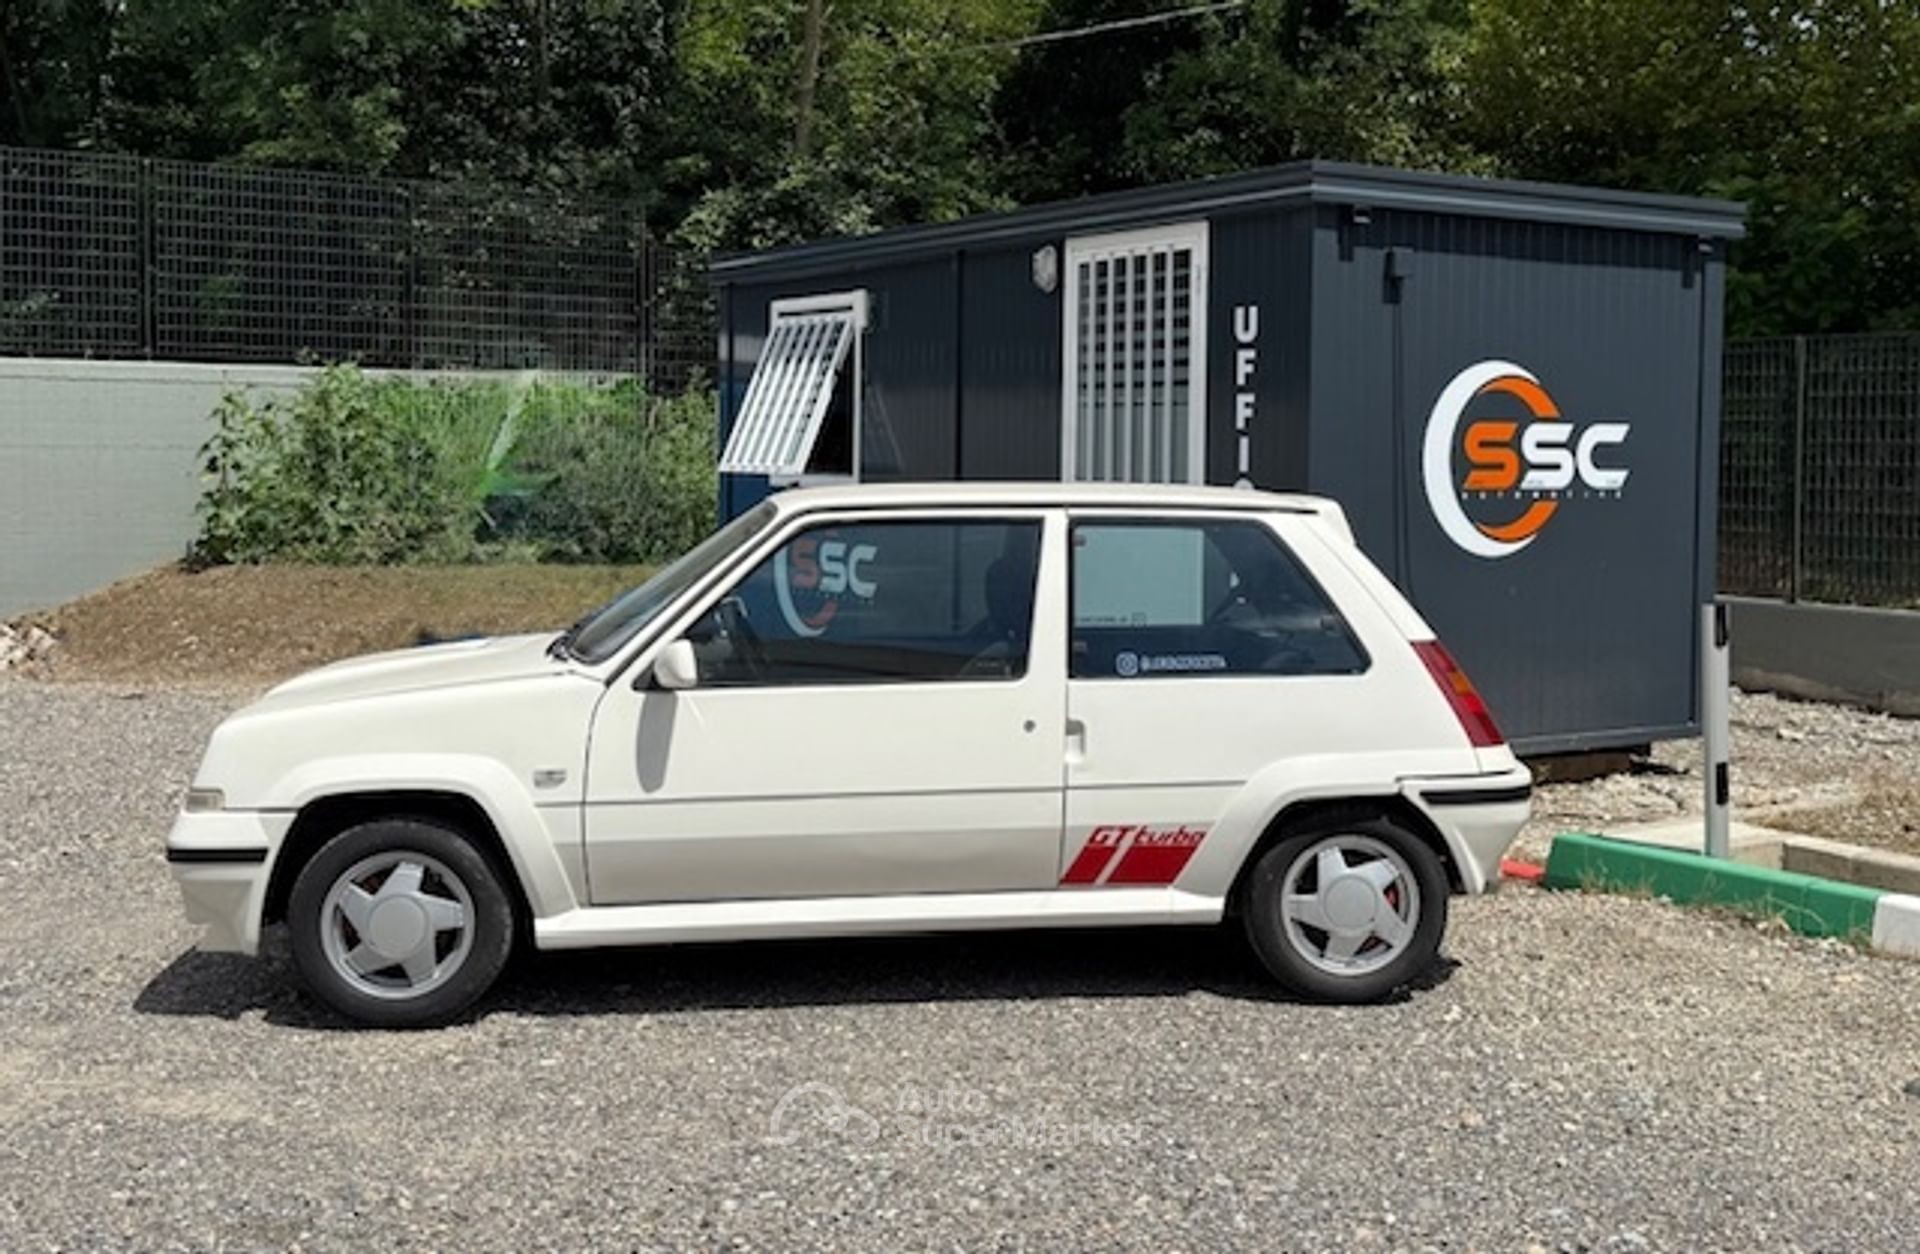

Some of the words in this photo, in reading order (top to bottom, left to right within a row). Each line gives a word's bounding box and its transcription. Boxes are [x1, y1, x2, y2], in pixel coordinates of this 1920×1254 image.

[1463, 422, 1630, 490] SSC
[793, 538, 878, 598] SSC
[1088, 825, 1138, 846] GT
[1132, 825, 1207, 846] turbo
